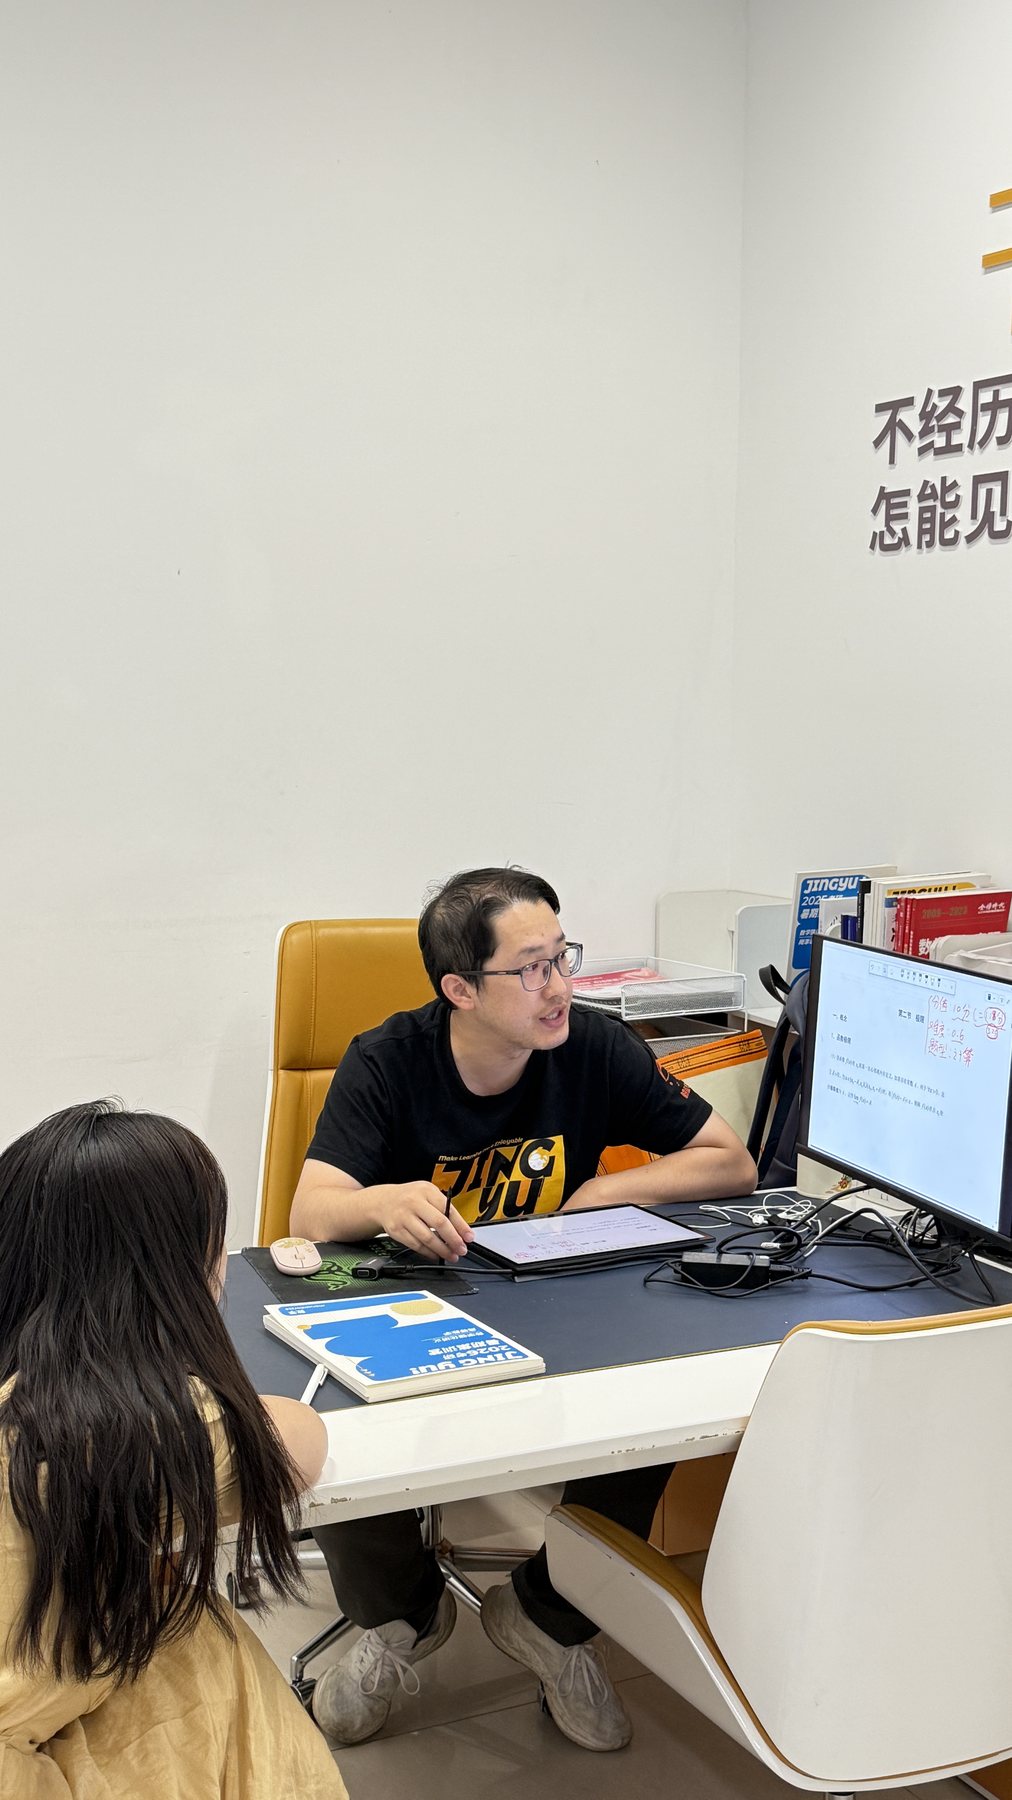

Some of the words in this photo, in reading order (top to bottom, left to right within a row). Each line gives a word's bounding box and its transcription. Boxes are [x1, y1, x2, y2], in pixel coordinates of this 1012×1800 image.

[872, 373, 1012, 466] 不经历
[869, 470, 1012, 553] 怎能见
[804, 877, 863, 894] JINGYU
[459, 1350, 523, 1366] JING
[410, 1359, 457, 1375] YU!
